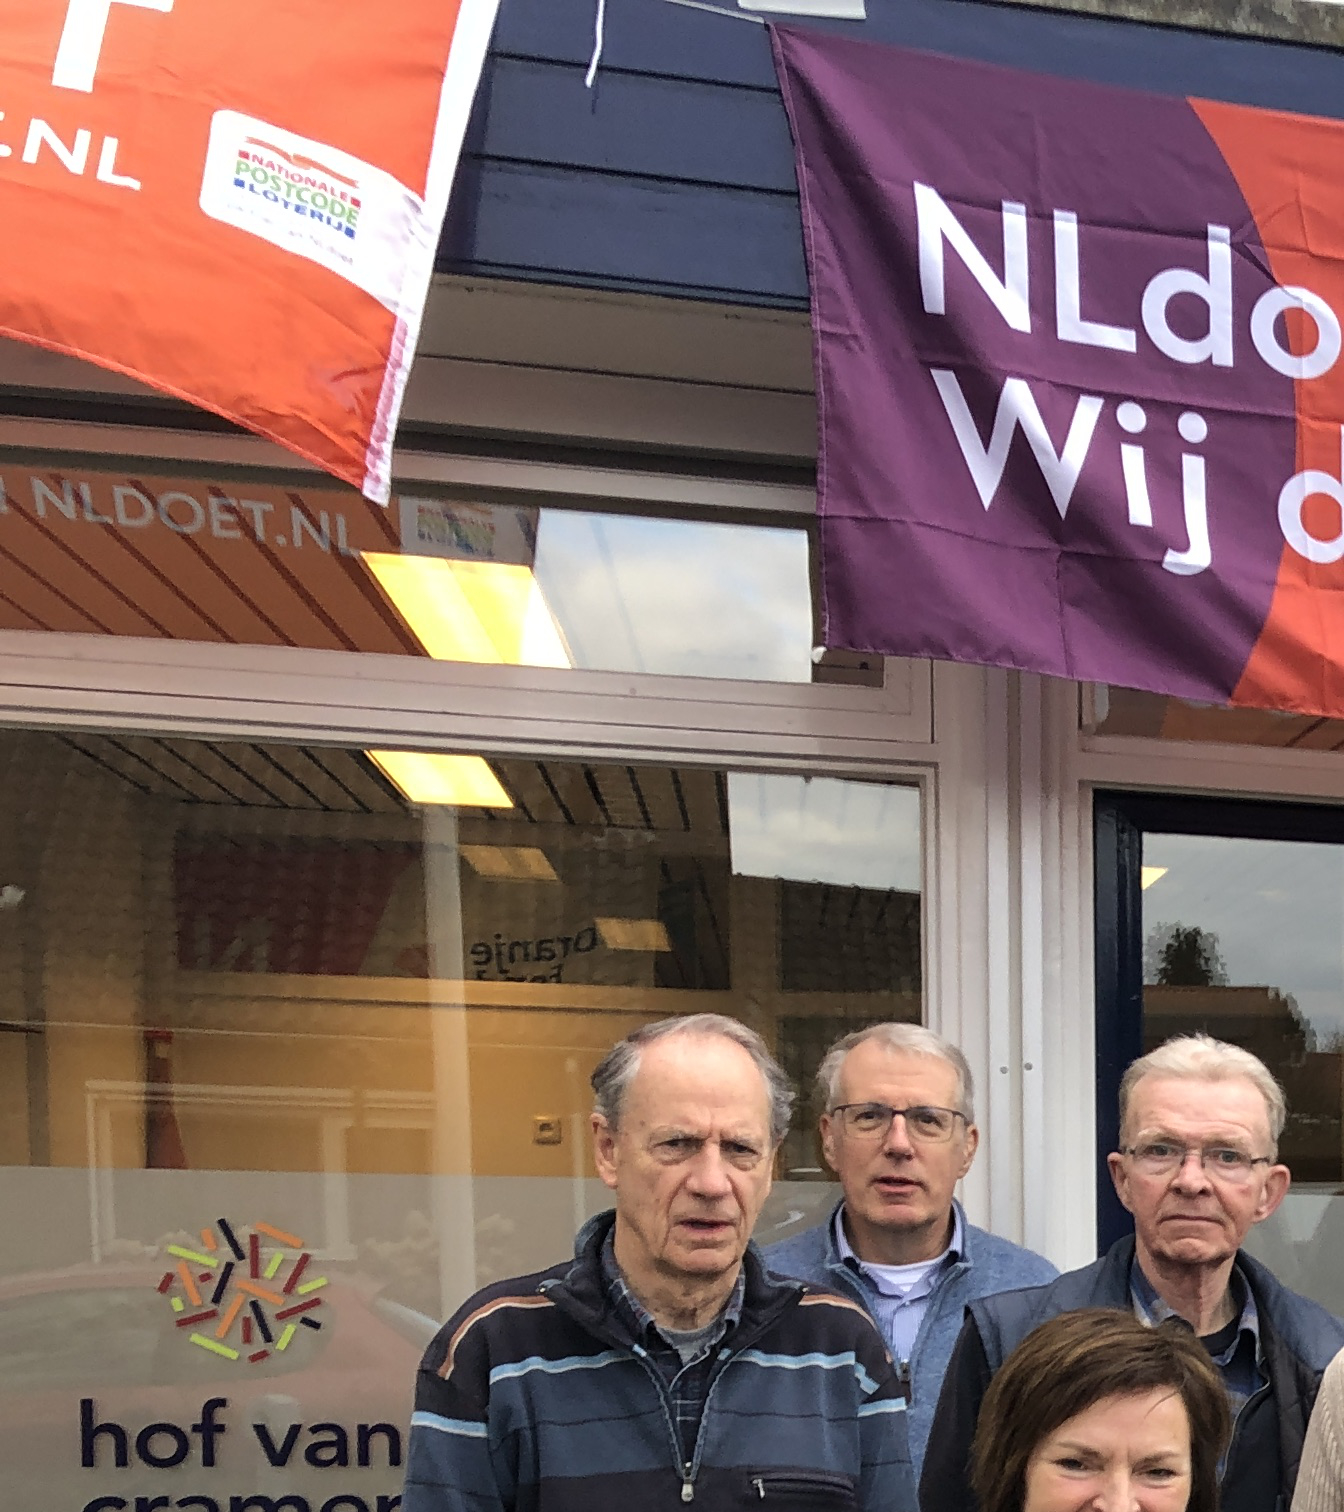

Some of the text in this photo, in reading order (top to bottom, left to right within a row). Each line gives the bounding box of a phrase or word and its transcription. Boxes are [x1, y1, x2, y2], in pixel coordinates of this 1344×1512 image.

[0, 110, 142, 191] .NL
[252, 154, 349, 202] NATIONALE
[235, 160, 360, 228] POSTCODE
[249, 183, 343, 231] LOTERIJ
[930, 368, 1212, 575] Wij
[31, 476, 361, 558] NLDOET.NL
[80, 1397, 402, 1468] hof van
